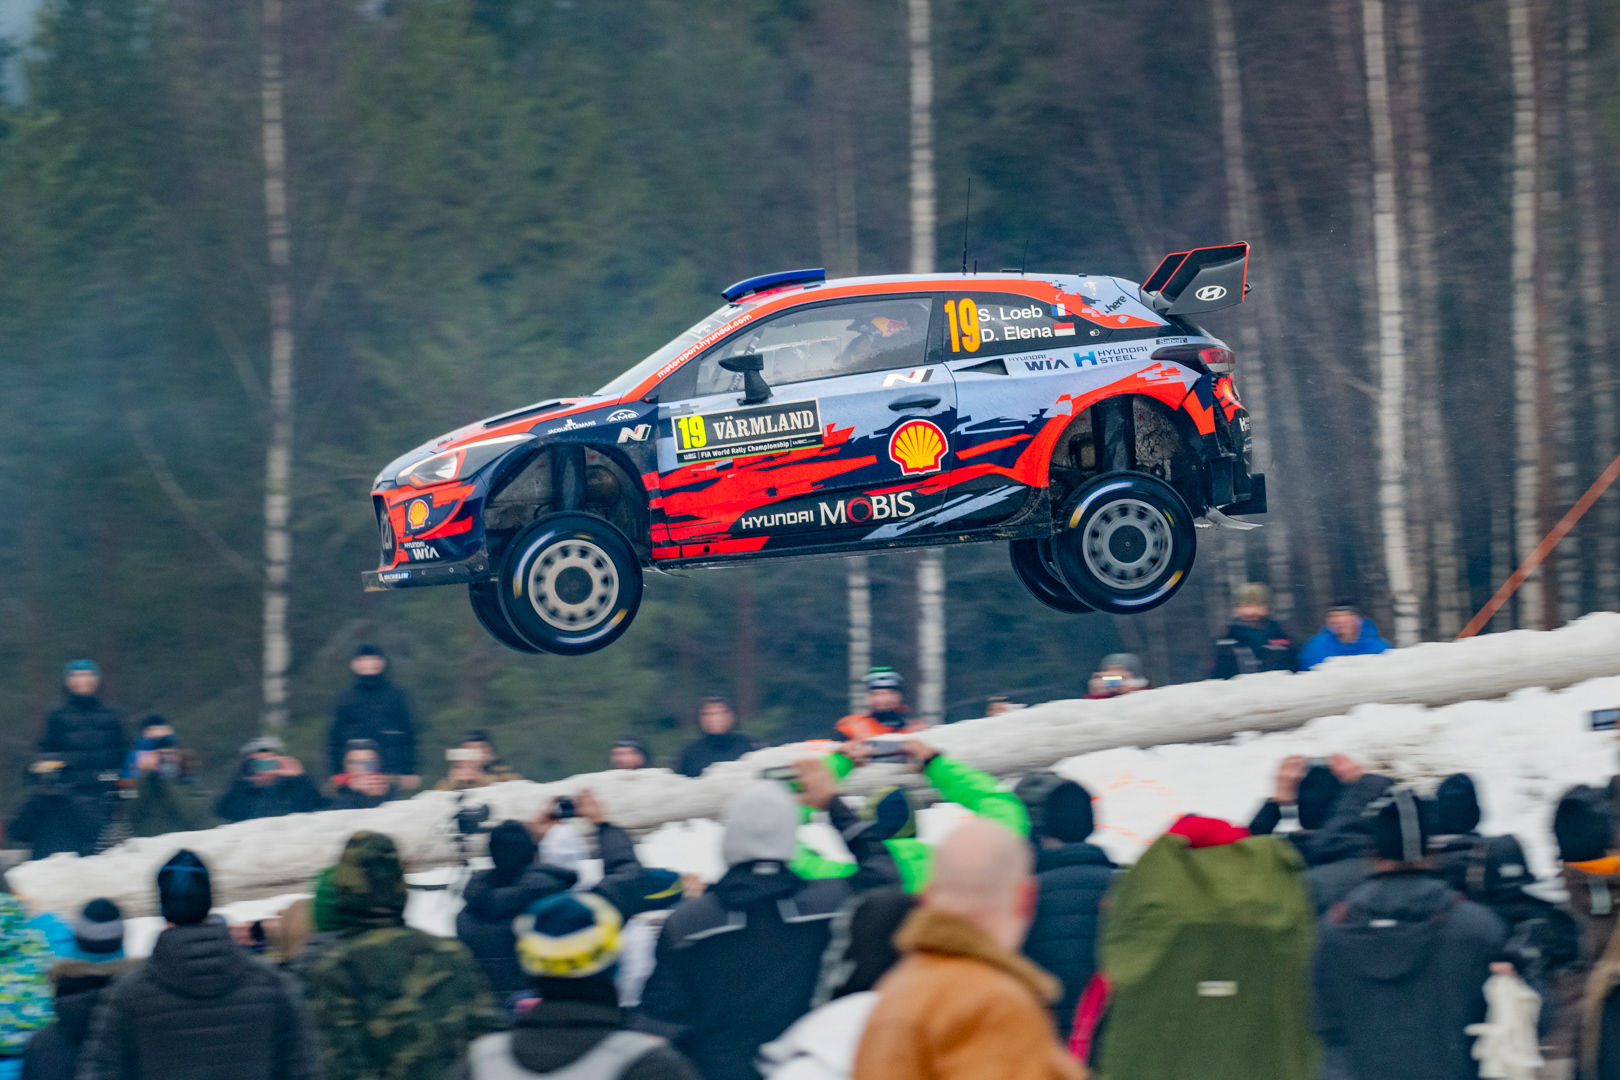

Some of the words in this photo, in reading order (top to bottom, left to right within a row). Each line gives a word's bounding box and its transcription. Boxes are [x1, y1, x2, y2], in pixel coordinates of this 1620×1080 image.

[1105, 295, 1127, 312] here
[978, 308, 995, 322] S.
[1000, 305, 1043, 321] Loeb
[944, 298, 980, 352] 19
[981, 328, 999, 342] D.
[1003, 324, 1052, 341] Elena
[657, 313, 752, 378] motorsport.hyundai.com
[1098, 346, 1148, 356] HYUNDAI
[1008, 354, 1047, 362] HYUNDAI
[1101, 354, 1137, 364] STEEL
[573, 420, 597, 429] LEMANS
[678, 415, 707, 449] 19
[713, 410, 814, 440] VÄRMLAND
[700, 451, 711, 459] FIA
[712, 447, 730, 457] World
[731, 446, 746, 455] Rally
[748, 441, 790, 453] Championship
[742, 510, 814, 529] HYUNDAI
[818, 491, 915, 526] MOBIS
[404, 541, 425, 549] HYUNDAI
